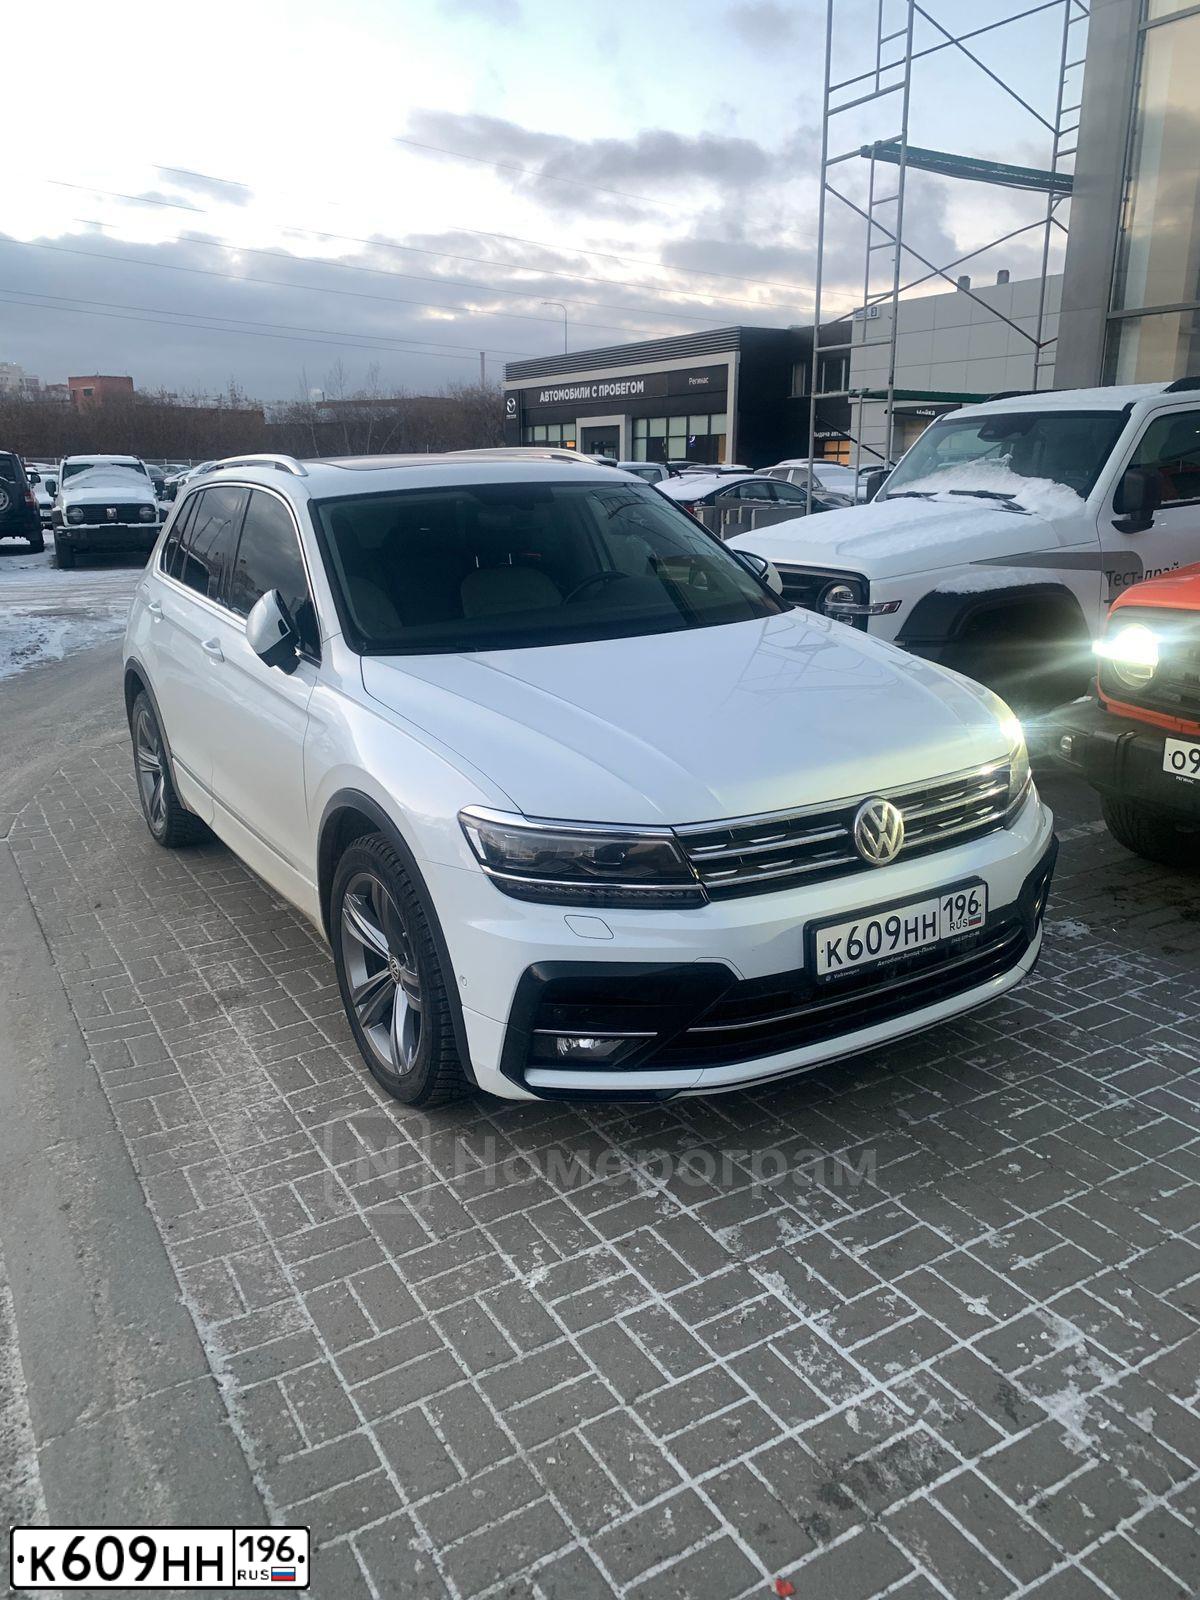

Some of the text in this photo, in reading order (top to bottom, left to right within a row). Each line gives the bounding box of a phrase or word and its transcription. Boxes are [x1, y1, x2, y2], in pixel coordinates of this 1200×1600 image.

[540, 381, 644, 403] АВТОМОБИЛИ С ПРОБЕГОМ
[826, 890, 979, 967] К609НН 196
[949, 918, 968, 932] RUS
